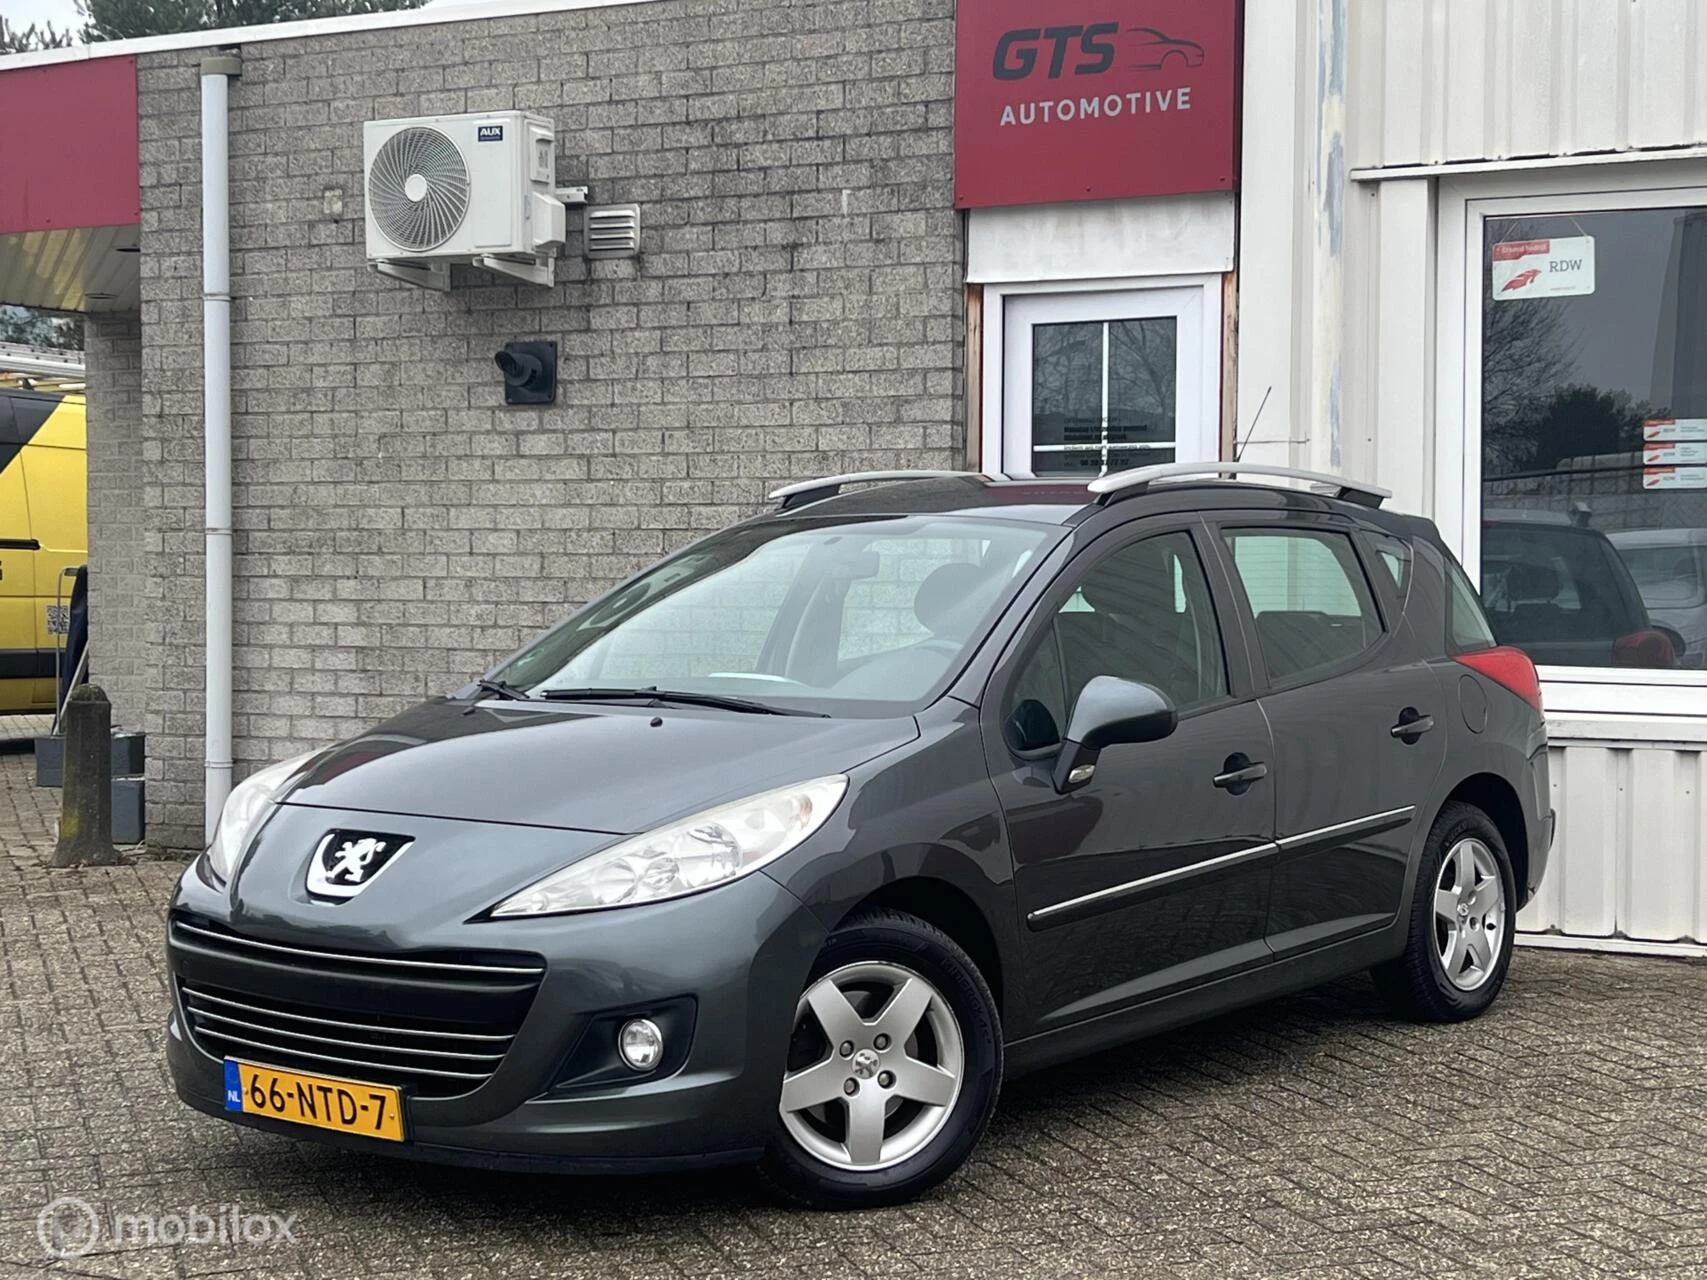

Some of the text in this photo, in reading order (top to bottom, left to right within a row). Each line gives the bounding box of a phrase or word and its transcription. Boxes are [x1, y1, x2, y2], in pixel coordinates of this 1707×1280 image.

[993, 22, 1120, 81] GTS
[999, 87, 1192, 126] AUTOMOTIVE
[480, 127, 501, 136] AUX
[1549, 259, 1582, 272] RDW
[227, 1090, 241, 1103] NL
[250, 1074, 387, 1130] 66-NTD-7
